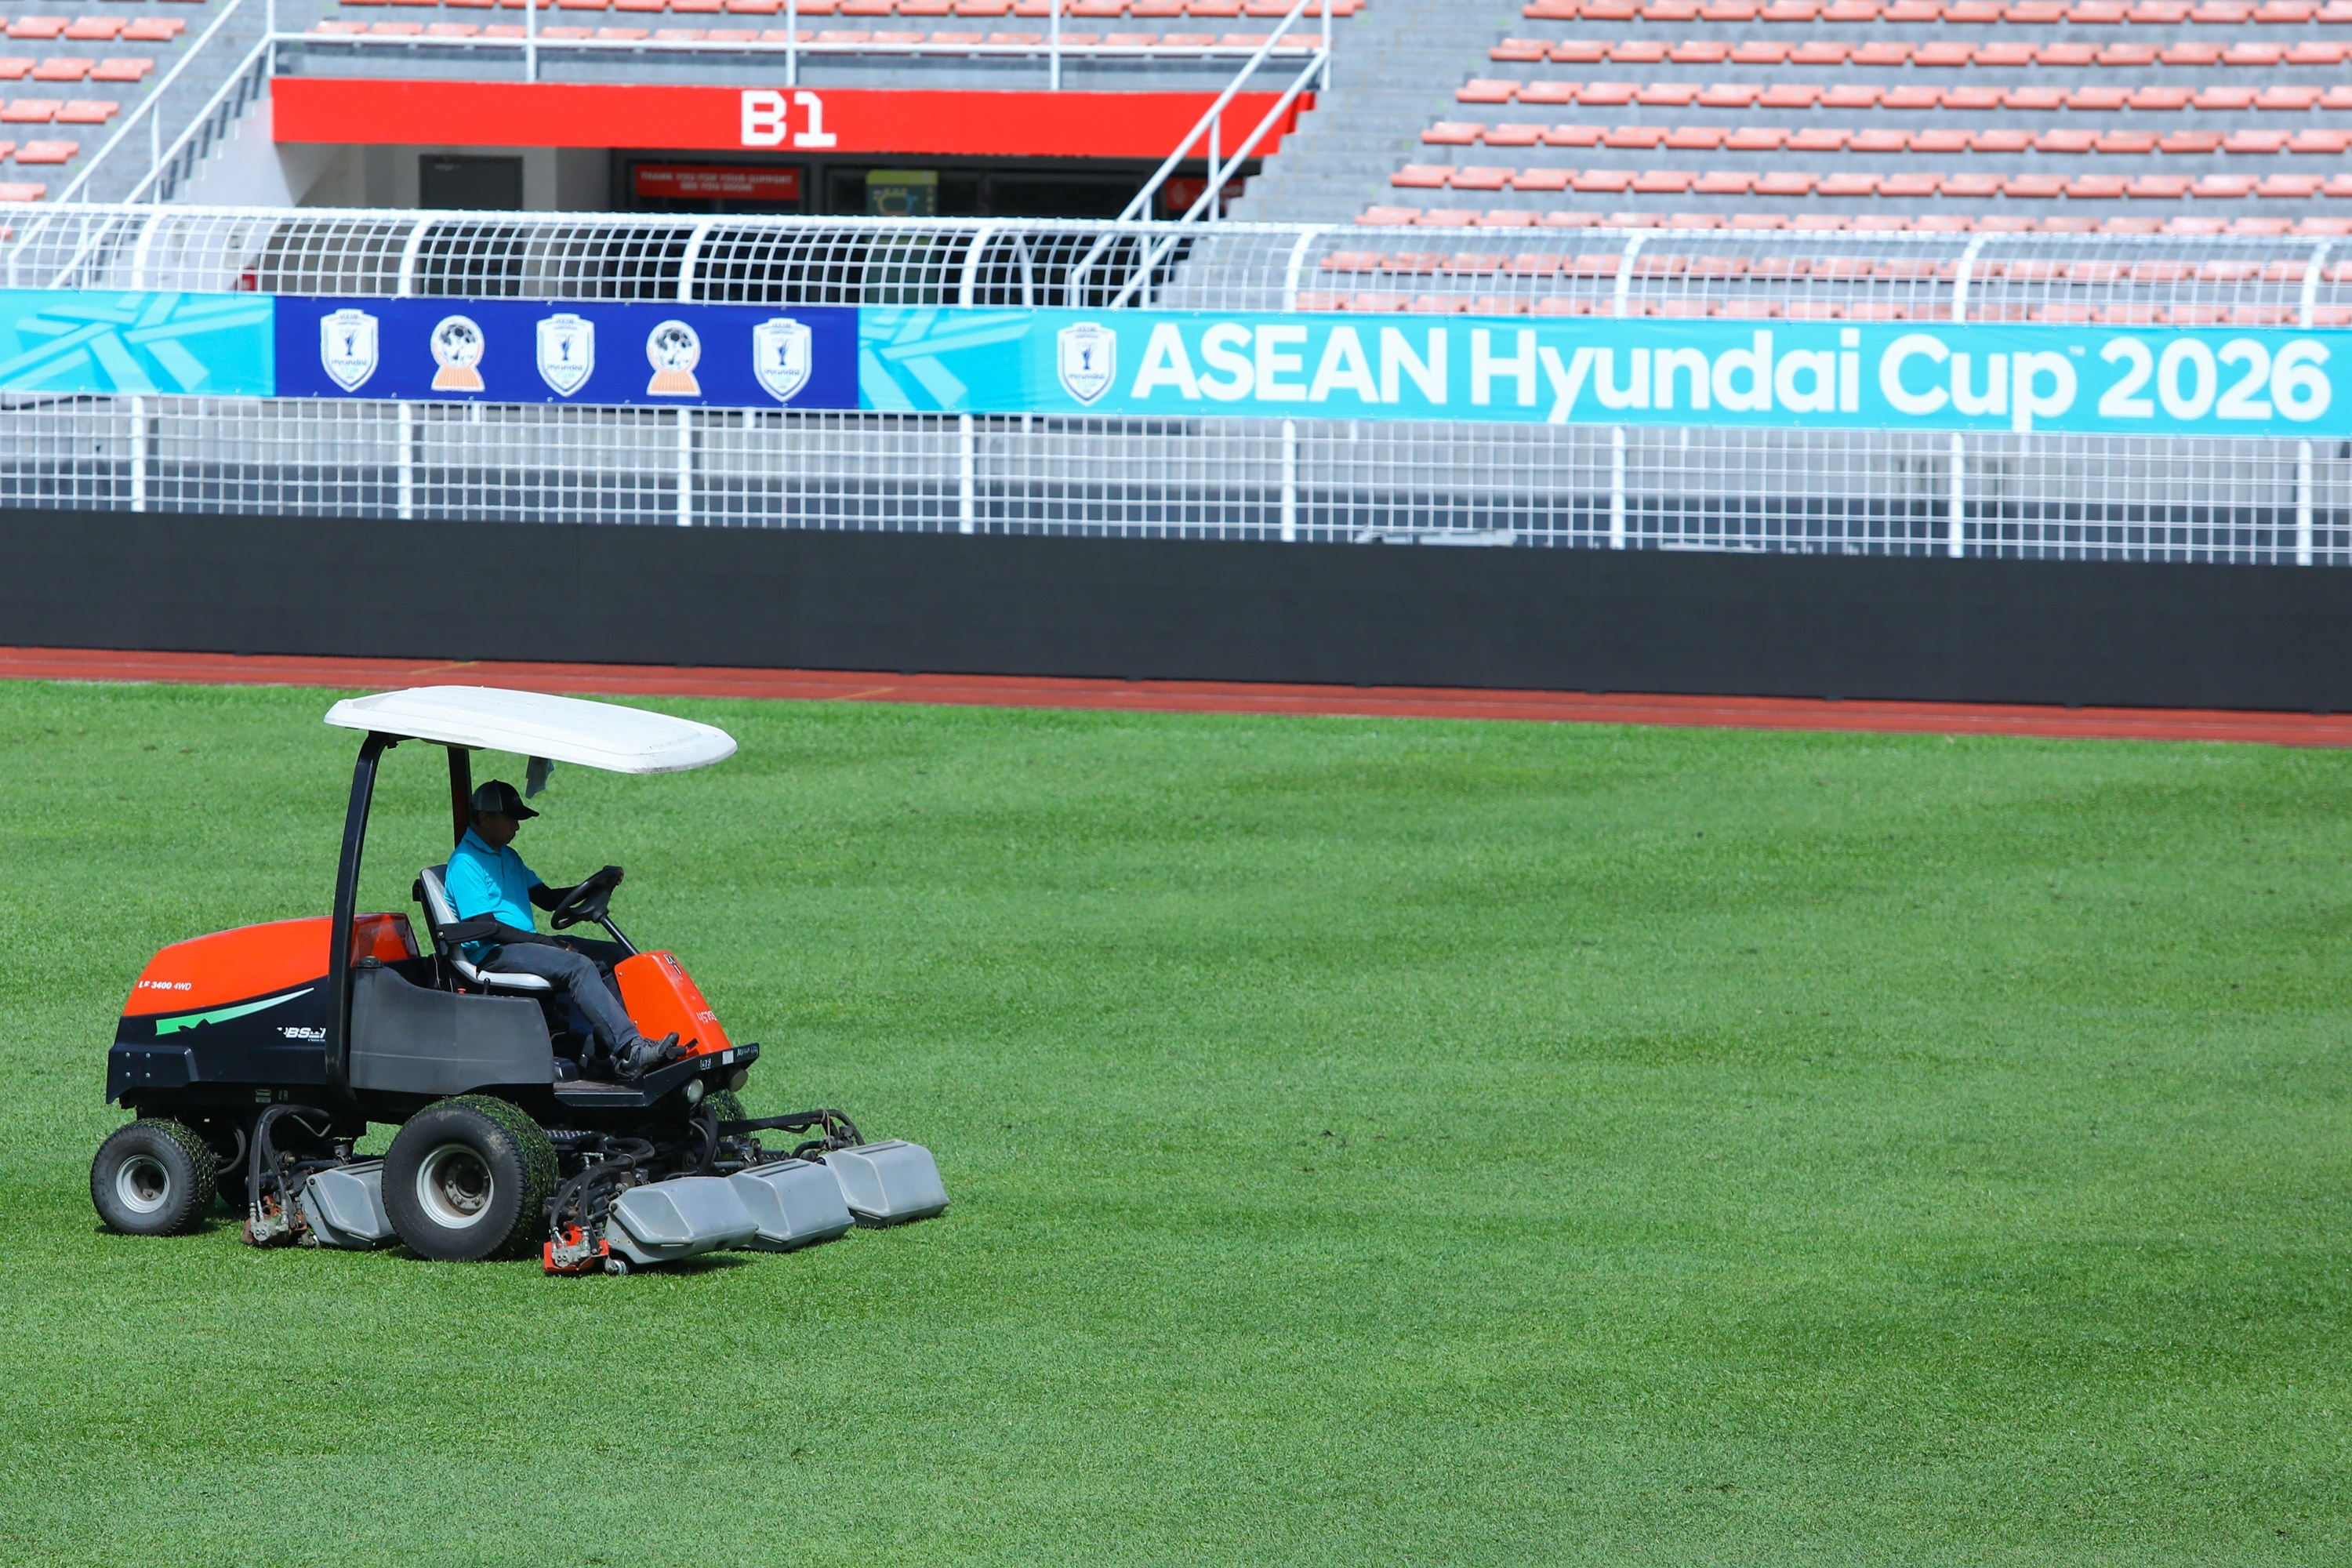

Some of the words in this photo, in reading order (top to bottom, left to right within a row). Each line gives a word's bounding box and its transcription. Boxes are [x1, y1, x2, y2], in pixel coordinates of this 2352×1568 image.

[741, 90, 837, 147] B1
[1131, 322, 1448, 405] ASEAN
[1471, 328, 1860, 425] Hyundai
[2098, 337, 2332, 422] 2026
[151, 981, 172, 989] 3400
[173, 982, 192, 991] 4WD
